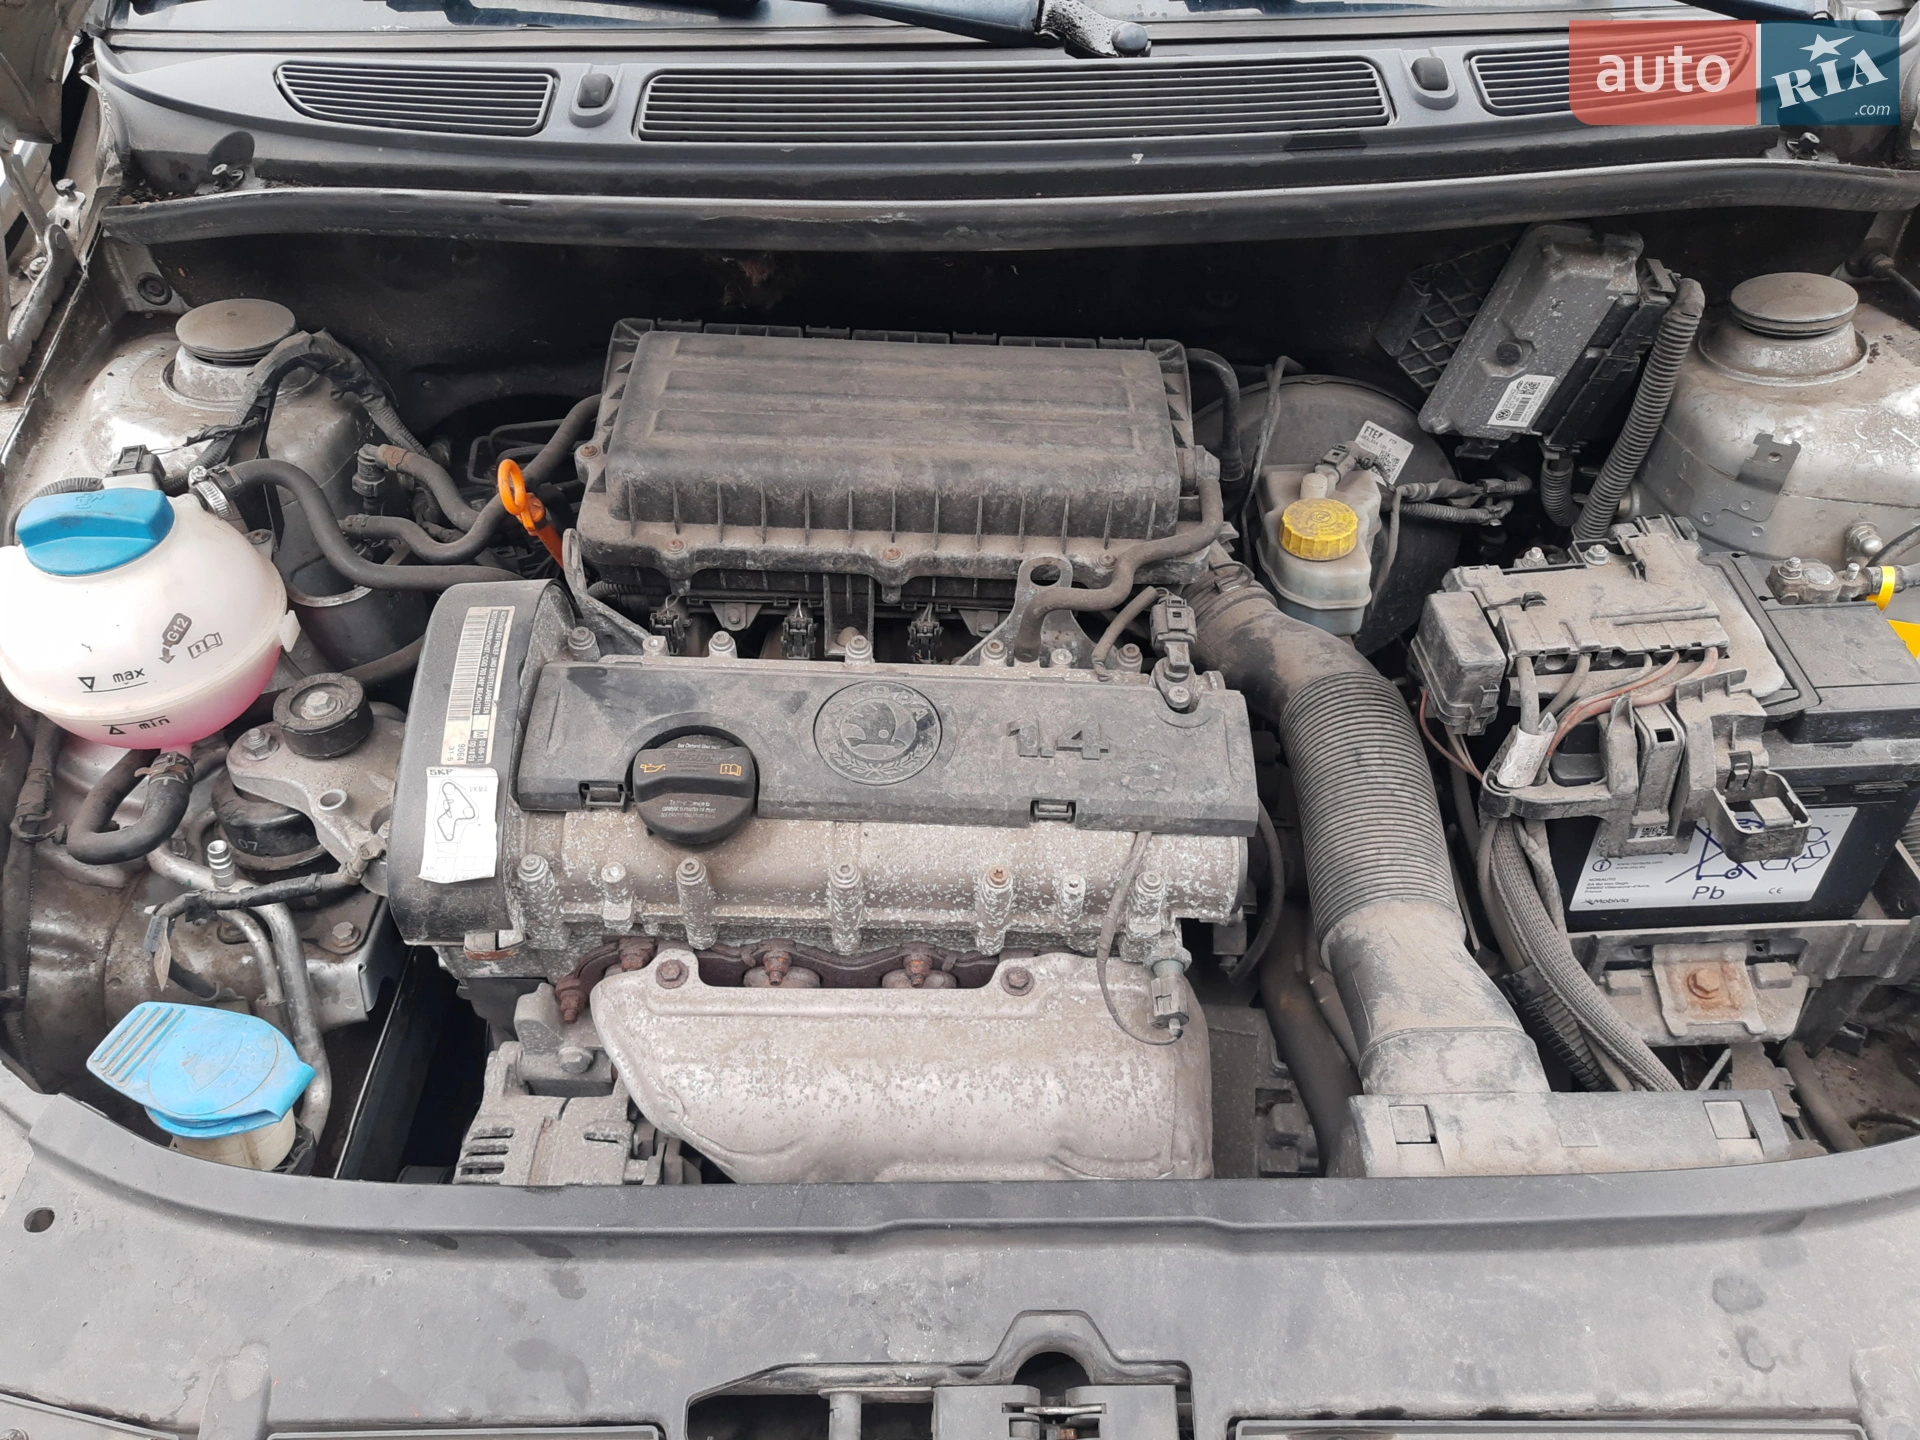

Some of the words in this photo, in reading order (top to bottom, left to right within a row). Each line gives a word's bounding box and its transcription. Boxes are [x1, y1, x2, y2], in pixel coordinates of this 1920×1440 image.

[1363, 425, 1379, 439] FTE
[166, 617, 189, 642] G12
[112, 668, 146, 683] max
[474, 687, 484, 714] BEACHTEN
[138, 718, 171, 730] min
[1007, 719, 1110, 760] 1.4
[457, 743, 467, 762] 9064
[429, 768, 454, 776] SKF
[238, 838, 258, 851] 07
[1691, 885, 1725, 901] Pb
